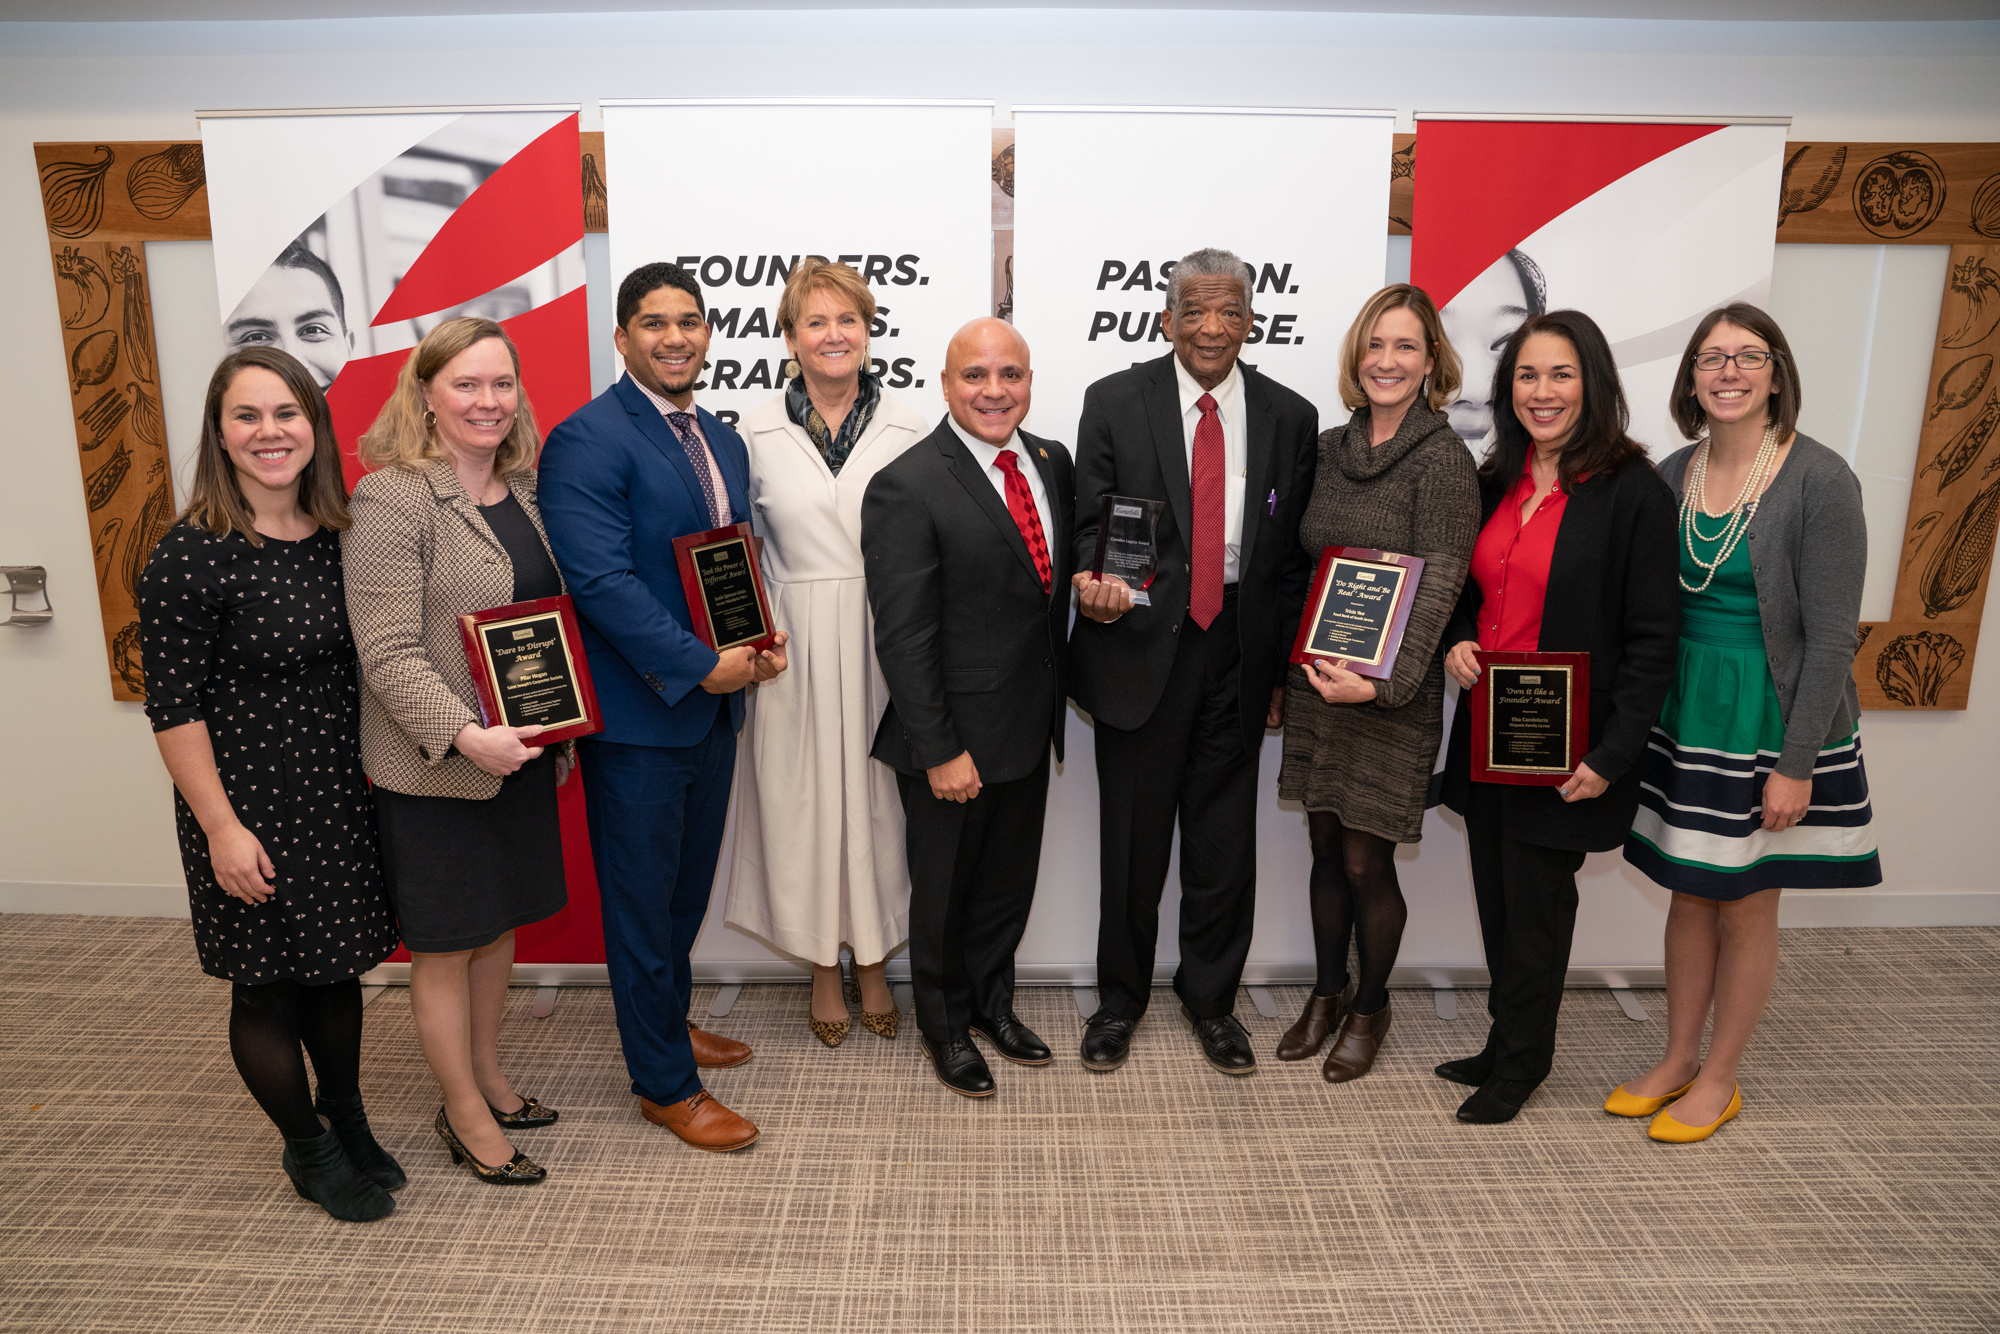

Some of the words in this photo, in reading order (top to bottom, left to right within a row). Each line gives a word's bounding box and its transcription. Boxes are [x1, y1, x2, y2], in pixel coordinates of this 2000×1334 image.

[676, 254, 930, 287] FOUNRS.
[1096, 260, 1300, 294] PASN.
[706, 307, 900, 338] MAS.
[1088, 311, 1304, 345] PURSE.
[693, 358, 925, 390] CRAFRS.
[1347, 582, 1367, 590] Right
[1357, 592, 1384, 601] Award
[515, 650, 542, 662] Award
